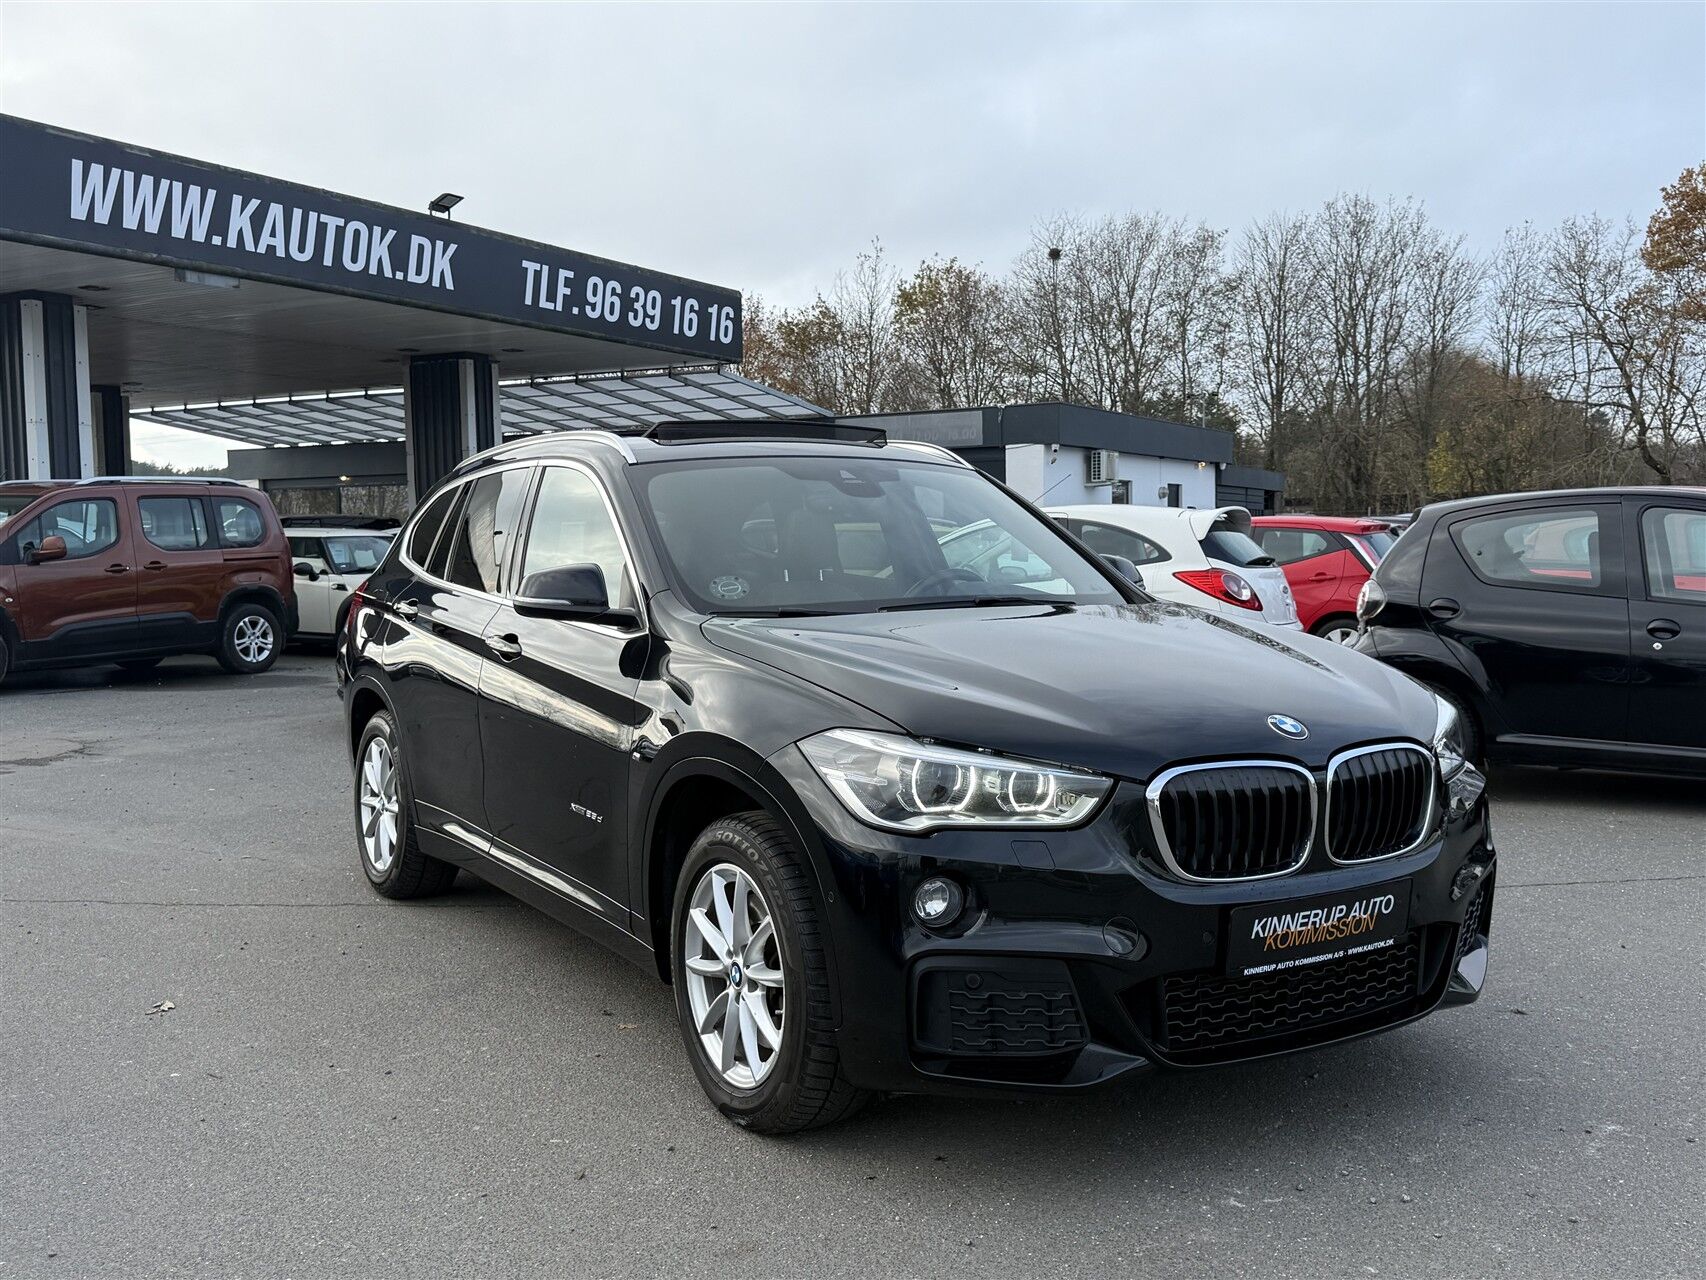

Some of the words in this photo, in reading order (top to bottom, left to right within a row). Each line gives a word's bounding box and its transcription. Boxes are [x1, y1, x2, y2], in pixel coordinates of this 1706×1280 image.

[71, 158, 458, 290] WWW.KAUTOK.DK
[521, 260, 579, 315] TLF.
[585, 276, 622, 323] 96
[628, 286, 662, 332] 39
[671, 295, 699, 338] 16
[708, 303, 735, 344] 16
[1251, 904, 1347, 939] KINNERUP
[1347, 894, 1395, 920] AUTO
[1263, 912, 1378, 951] KOMMISSION
[1243, 963, 1277, 976] KINNERUP
[1276, 960, 1295, 971] AUTO
[1294, 952, 1333, 967] KOMMISSION
[1333, 950, 1345, 960] A/S
[1347, 938, 1395, 955] WWW.KAUTOK.DK
